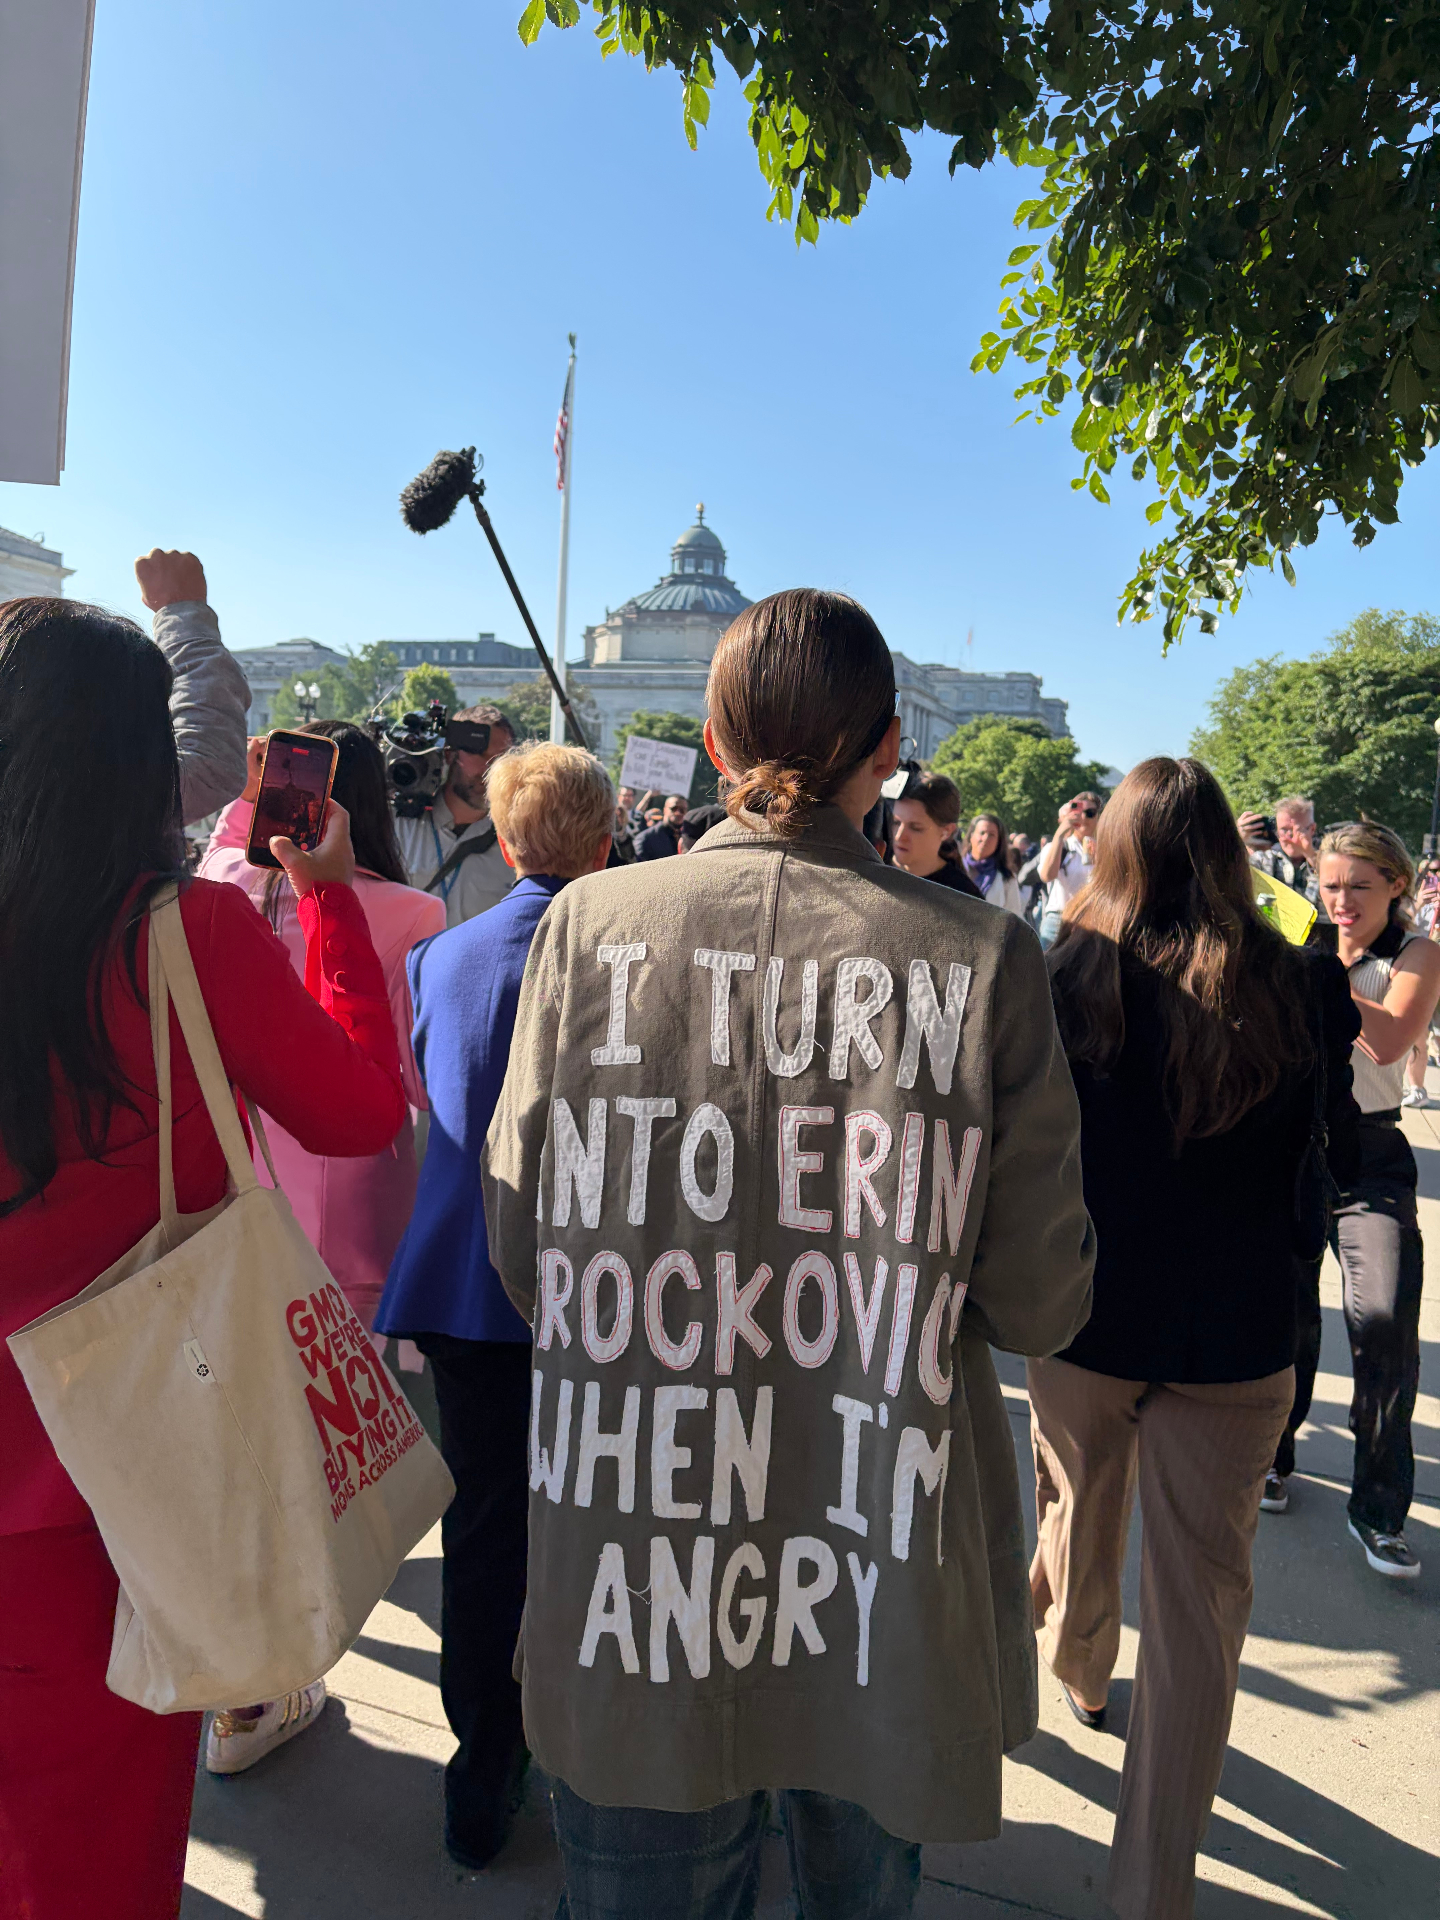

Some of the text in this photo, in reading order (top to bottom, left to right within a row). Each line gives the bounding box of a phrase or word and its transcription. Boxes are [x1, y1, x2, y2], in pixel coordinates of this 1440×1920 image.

[590, 942, 972, 1095] I TURN
[537, 1096, 982, 1257] NTO ERIN
[286, 1283, 354, 1349] GMO
[298, 1316, 369, 1379] WE'RE
[304, 1341, 397, 1456] NOT
[323, 1408, 398, 1498] BUYING
[358, 1444, 398, 1492] ACROSS
[395, 1421, 425, 1458] AMERIC
[529, 1369, 953, 1567] WHEN I'M
[577, 1535, 879, 1687] ANGRY
